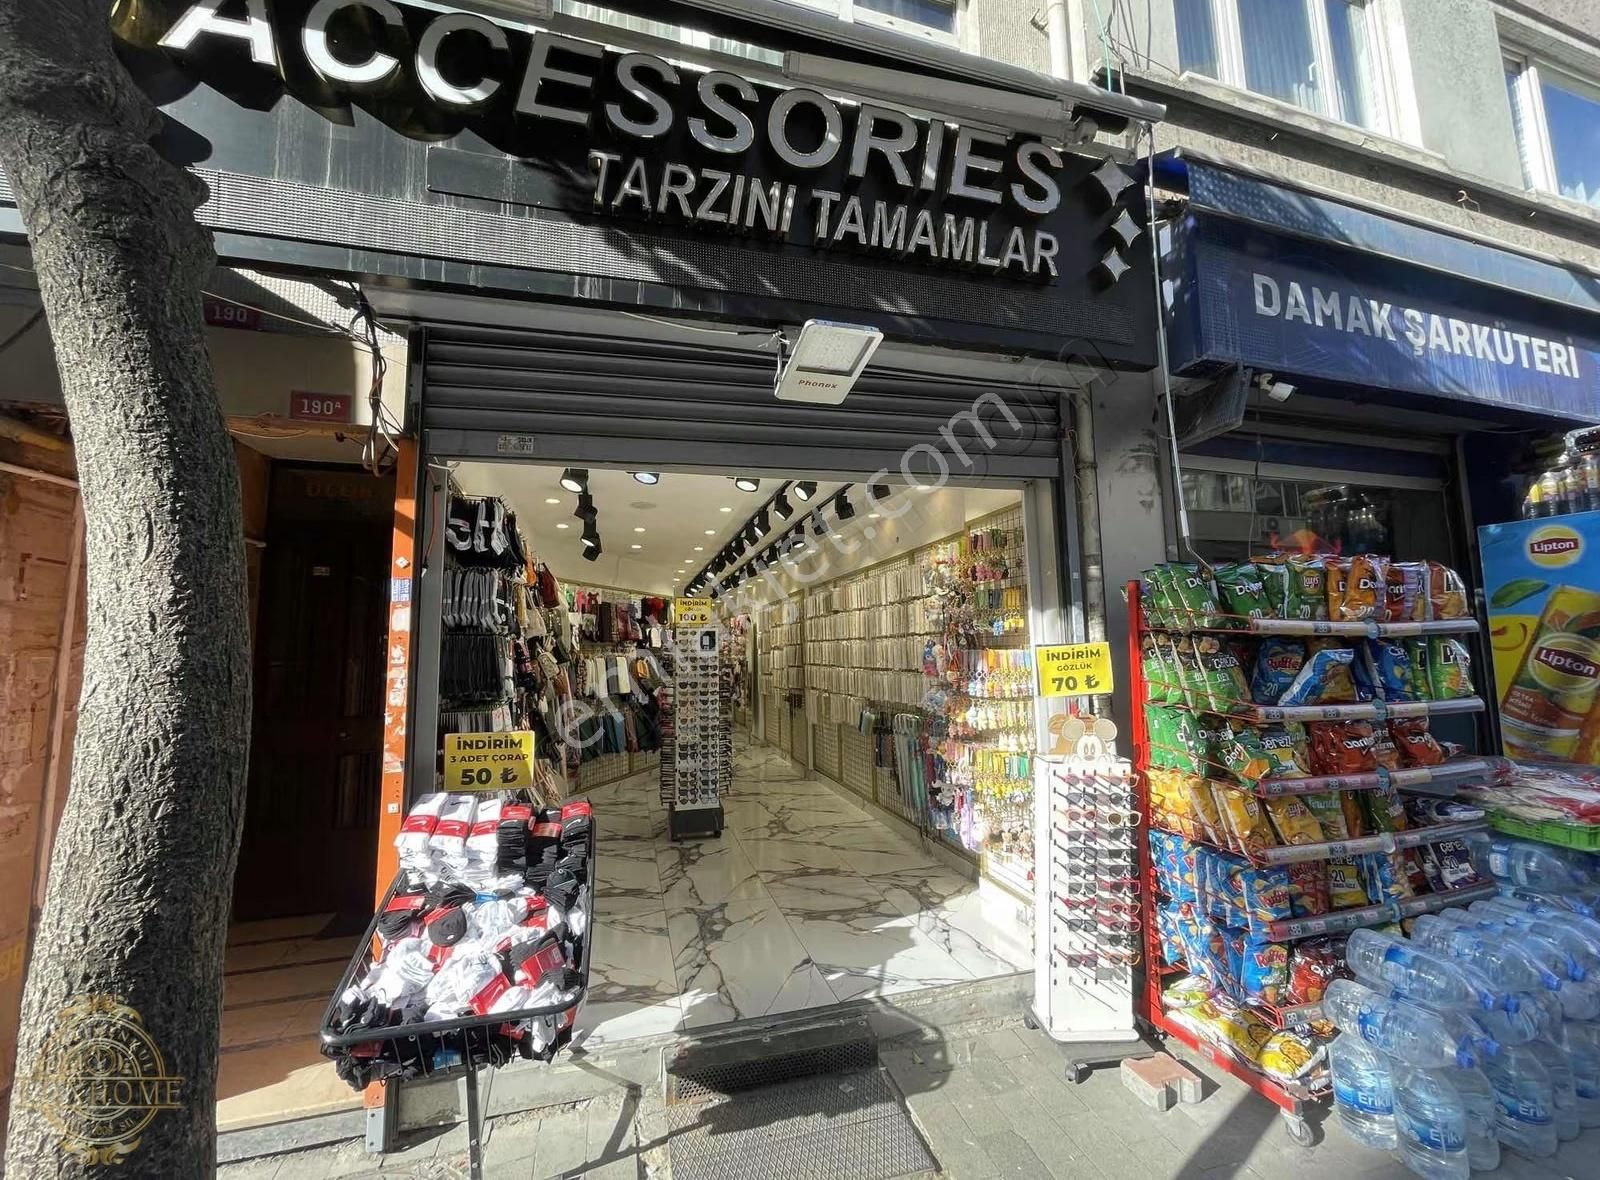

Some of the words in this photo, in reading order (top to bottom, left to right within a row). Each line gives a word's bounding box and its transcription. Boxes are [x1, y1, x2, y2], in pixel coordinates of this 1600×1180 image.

[157, 0, 1064, 214] ACCESSORIES
[588, 149, 796, 234] TARZINI
[811, 188, 1060, 278] TAMAMLAR
[213, 305, 248, 322] 190
[1252, 273, 1397, 341] DAMAK
[1404, 308, 1581, 379] ŞARKÜTERİ
[1533, 539, 1576, 553] Lipton
[1046, 646, 1101, 662] İNDİRİM
[1539, 647, 1597, 677] Lipton
[1051, 675, 1078, 691] 70
[456, 735, 523, 751] İNDİRİM
[450, 755, 457, 763] 3
[460, 754, 489, 763] ADET
[491, 753, 529, 764] ÇORAP
[461, 767, 492, 786] 50
[500, 767, 519, 784] ₺
